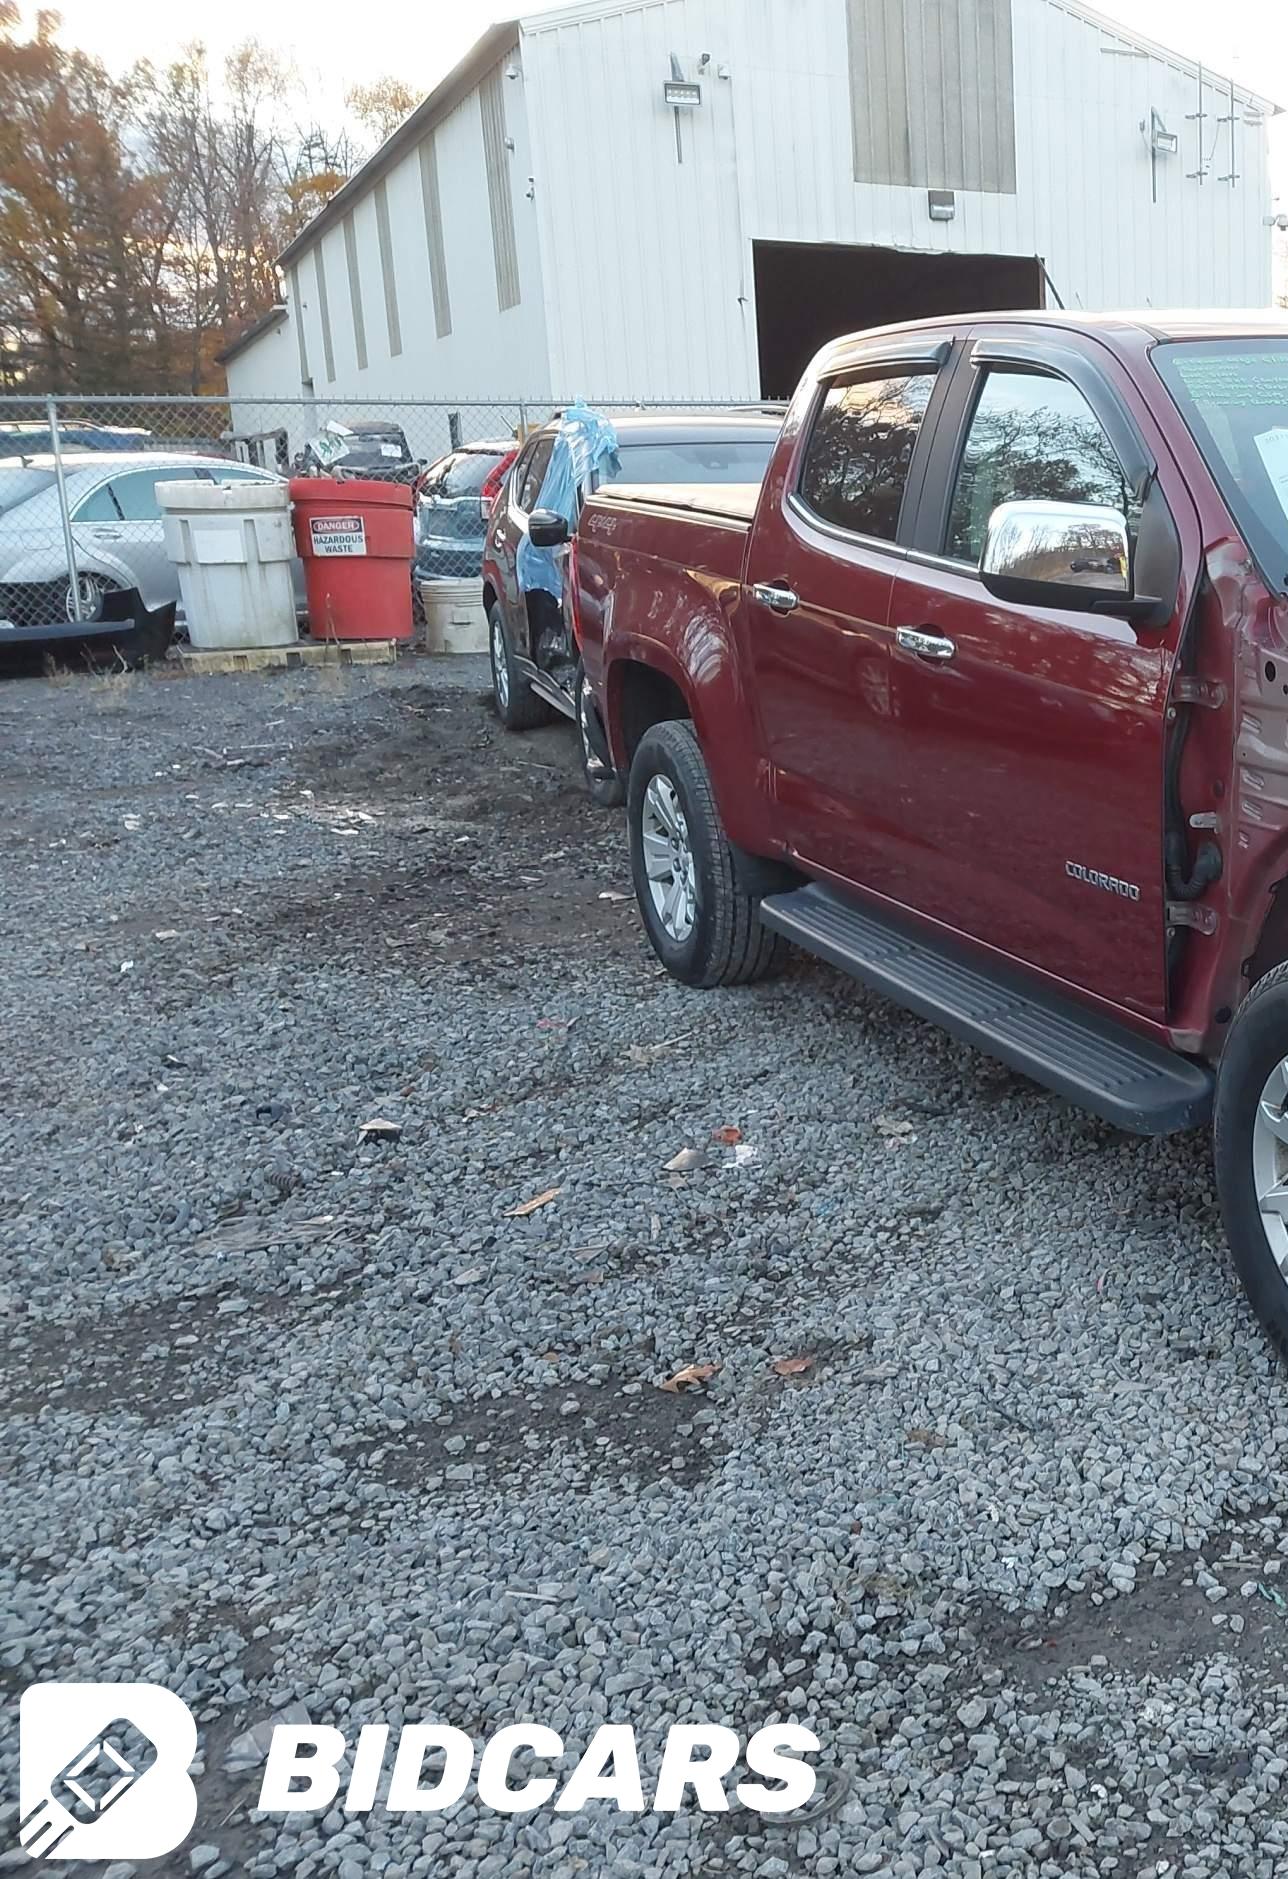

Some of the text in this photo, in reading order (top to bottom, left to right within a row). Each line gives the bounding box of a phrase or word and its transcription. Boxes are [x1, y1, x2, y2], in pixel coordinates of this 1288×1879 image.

[317, 521, 354, 530] DANGER
[313, 535, 363, 544] HAZARDOUS
[324, 545, 353, 553] WASTE
[1065, 860, 1140, 901] COLORADO
